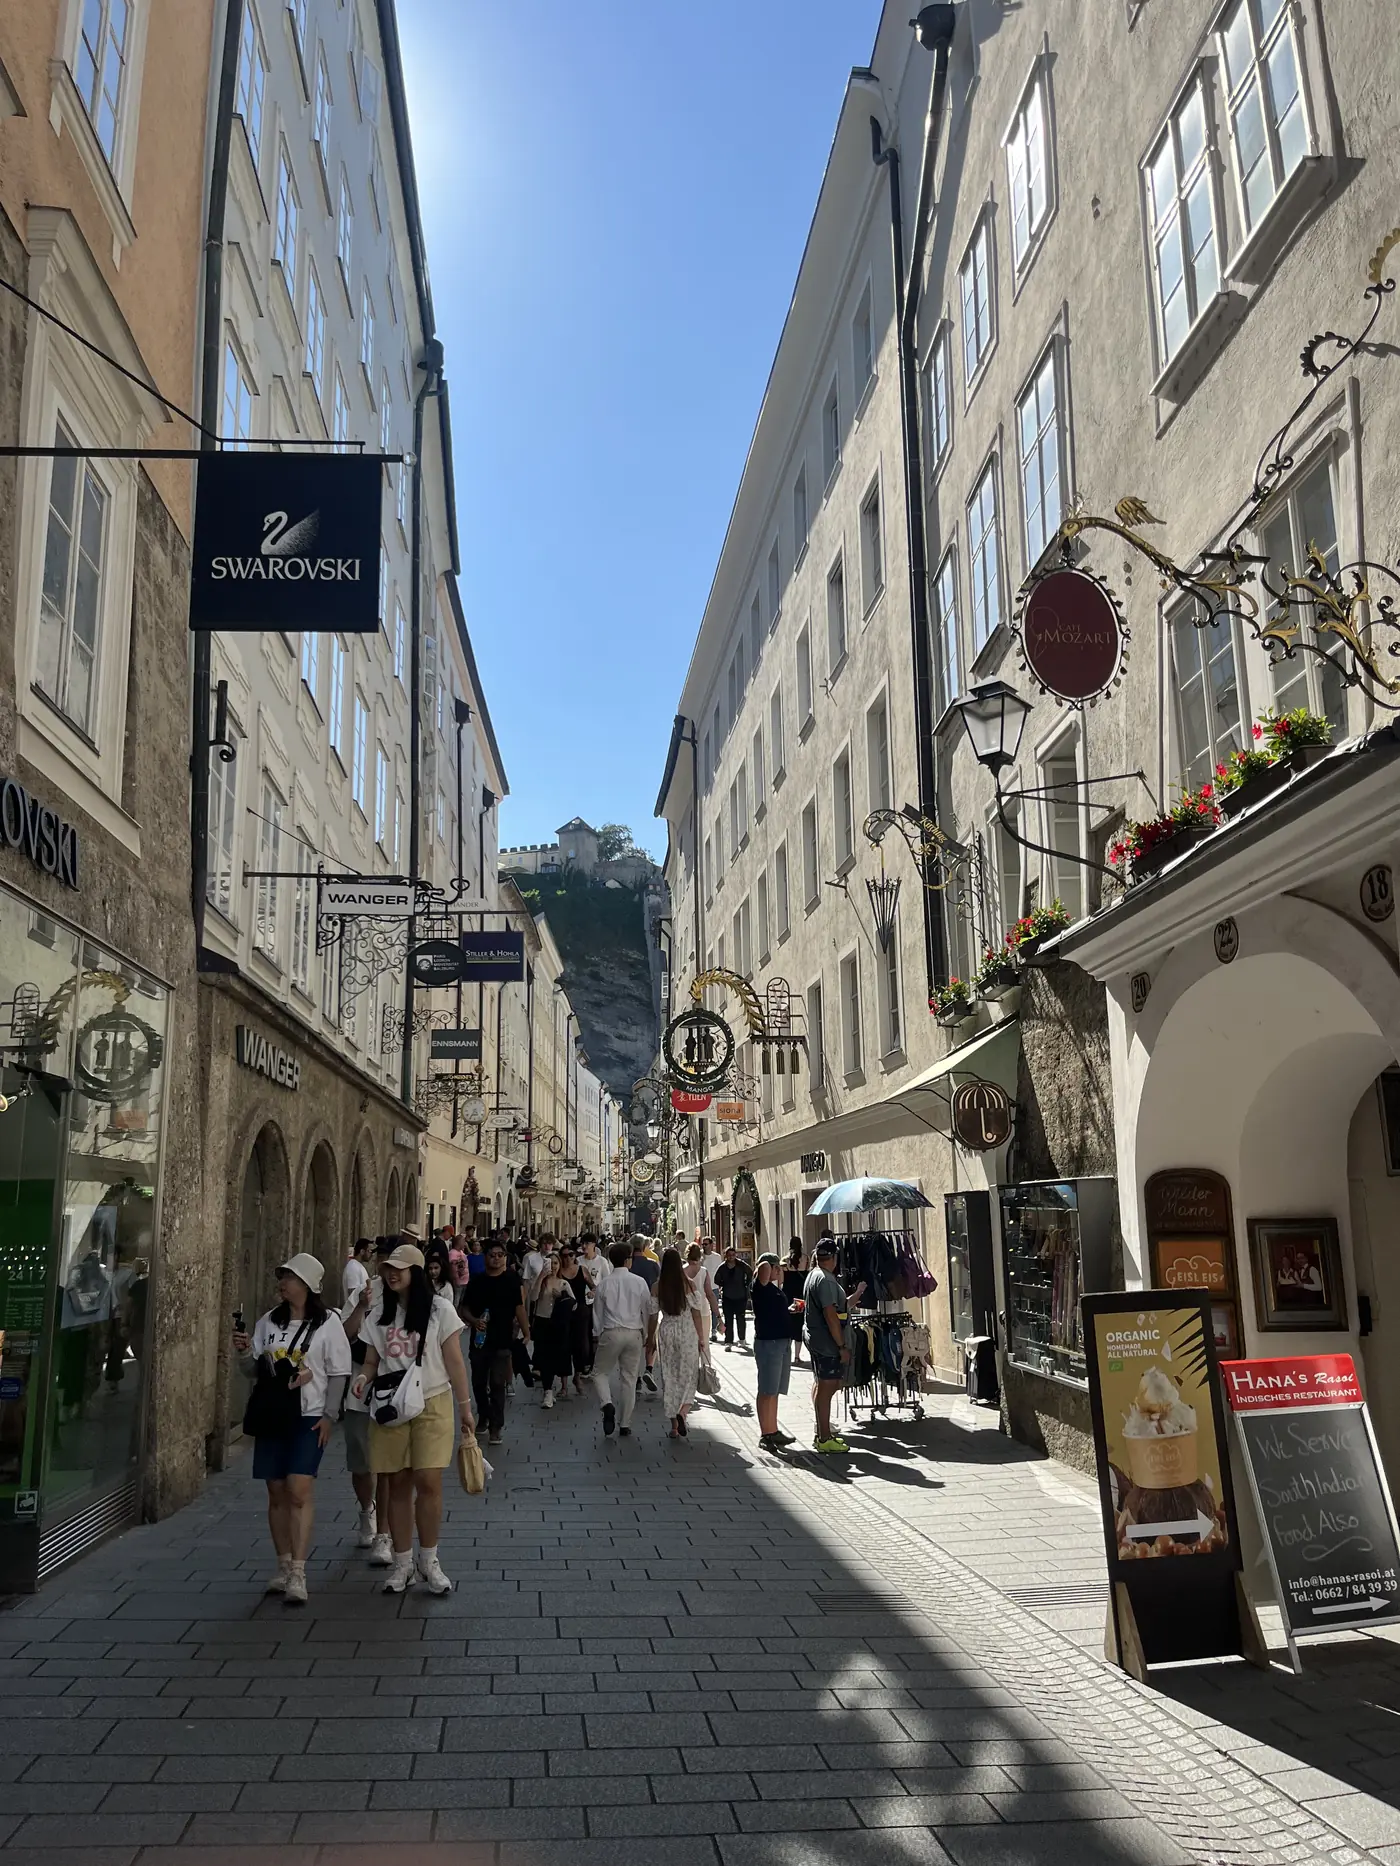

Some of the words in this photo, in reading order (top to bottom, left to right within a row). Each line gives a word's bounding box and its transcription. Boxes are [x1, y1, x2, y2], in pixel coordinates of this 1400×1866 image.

[211, 557, 361, 581] SWAROVSKI
[1044, 628, 1111, 644] MOZART
[1367, 869, 1388, 904] 18
[327, 893, 411, 906] WANGER
[1217, 920, 1233, 948] 22
[465, 949, 488, 957] STILLER
[489, 949, 495, 957] &
[1133, 976, 1147, 1000] 20
[431, 1040, 479, 1048] ENNSMANN
[243, 1025, 301, 1091] WANGER
[685, 1084, 714, 1094] MANGO
[719, 1106, 742, 1115] siona
[800, 1151, 825, 1174] MANGO
[8, 1270, 24, 1281] 24
[1176, 1271, 1200, 1283] EISL
[1202, 1272, 1218, 1284] EIS
[1105, 1329, 1161, 1343] ORGANIC
[1106, 1342, 1141, 1352] HOMEMADE
[1107, 1350, 1122, 1359] ALL
[1122, 1348, 1158, 1358] NATURAL
[1314, 1372, 1354, 1385] Rasoi
[1293, 1387, 1357, 1401] RESTAURANT
[1318, 1508, 1359, 1535] Also
[1288, 1568, 1396, 1590] info@hanas-rasoi.at
[1290, 1590, 1314, 1603] Tel.:
[1315, 1585, 1343, 1601] 0662
[1351, 1583, 1367, 1596] 84
[1367, 1581, 1382, 1594] 39
[1383, 1579, 1398, 1592] 39
